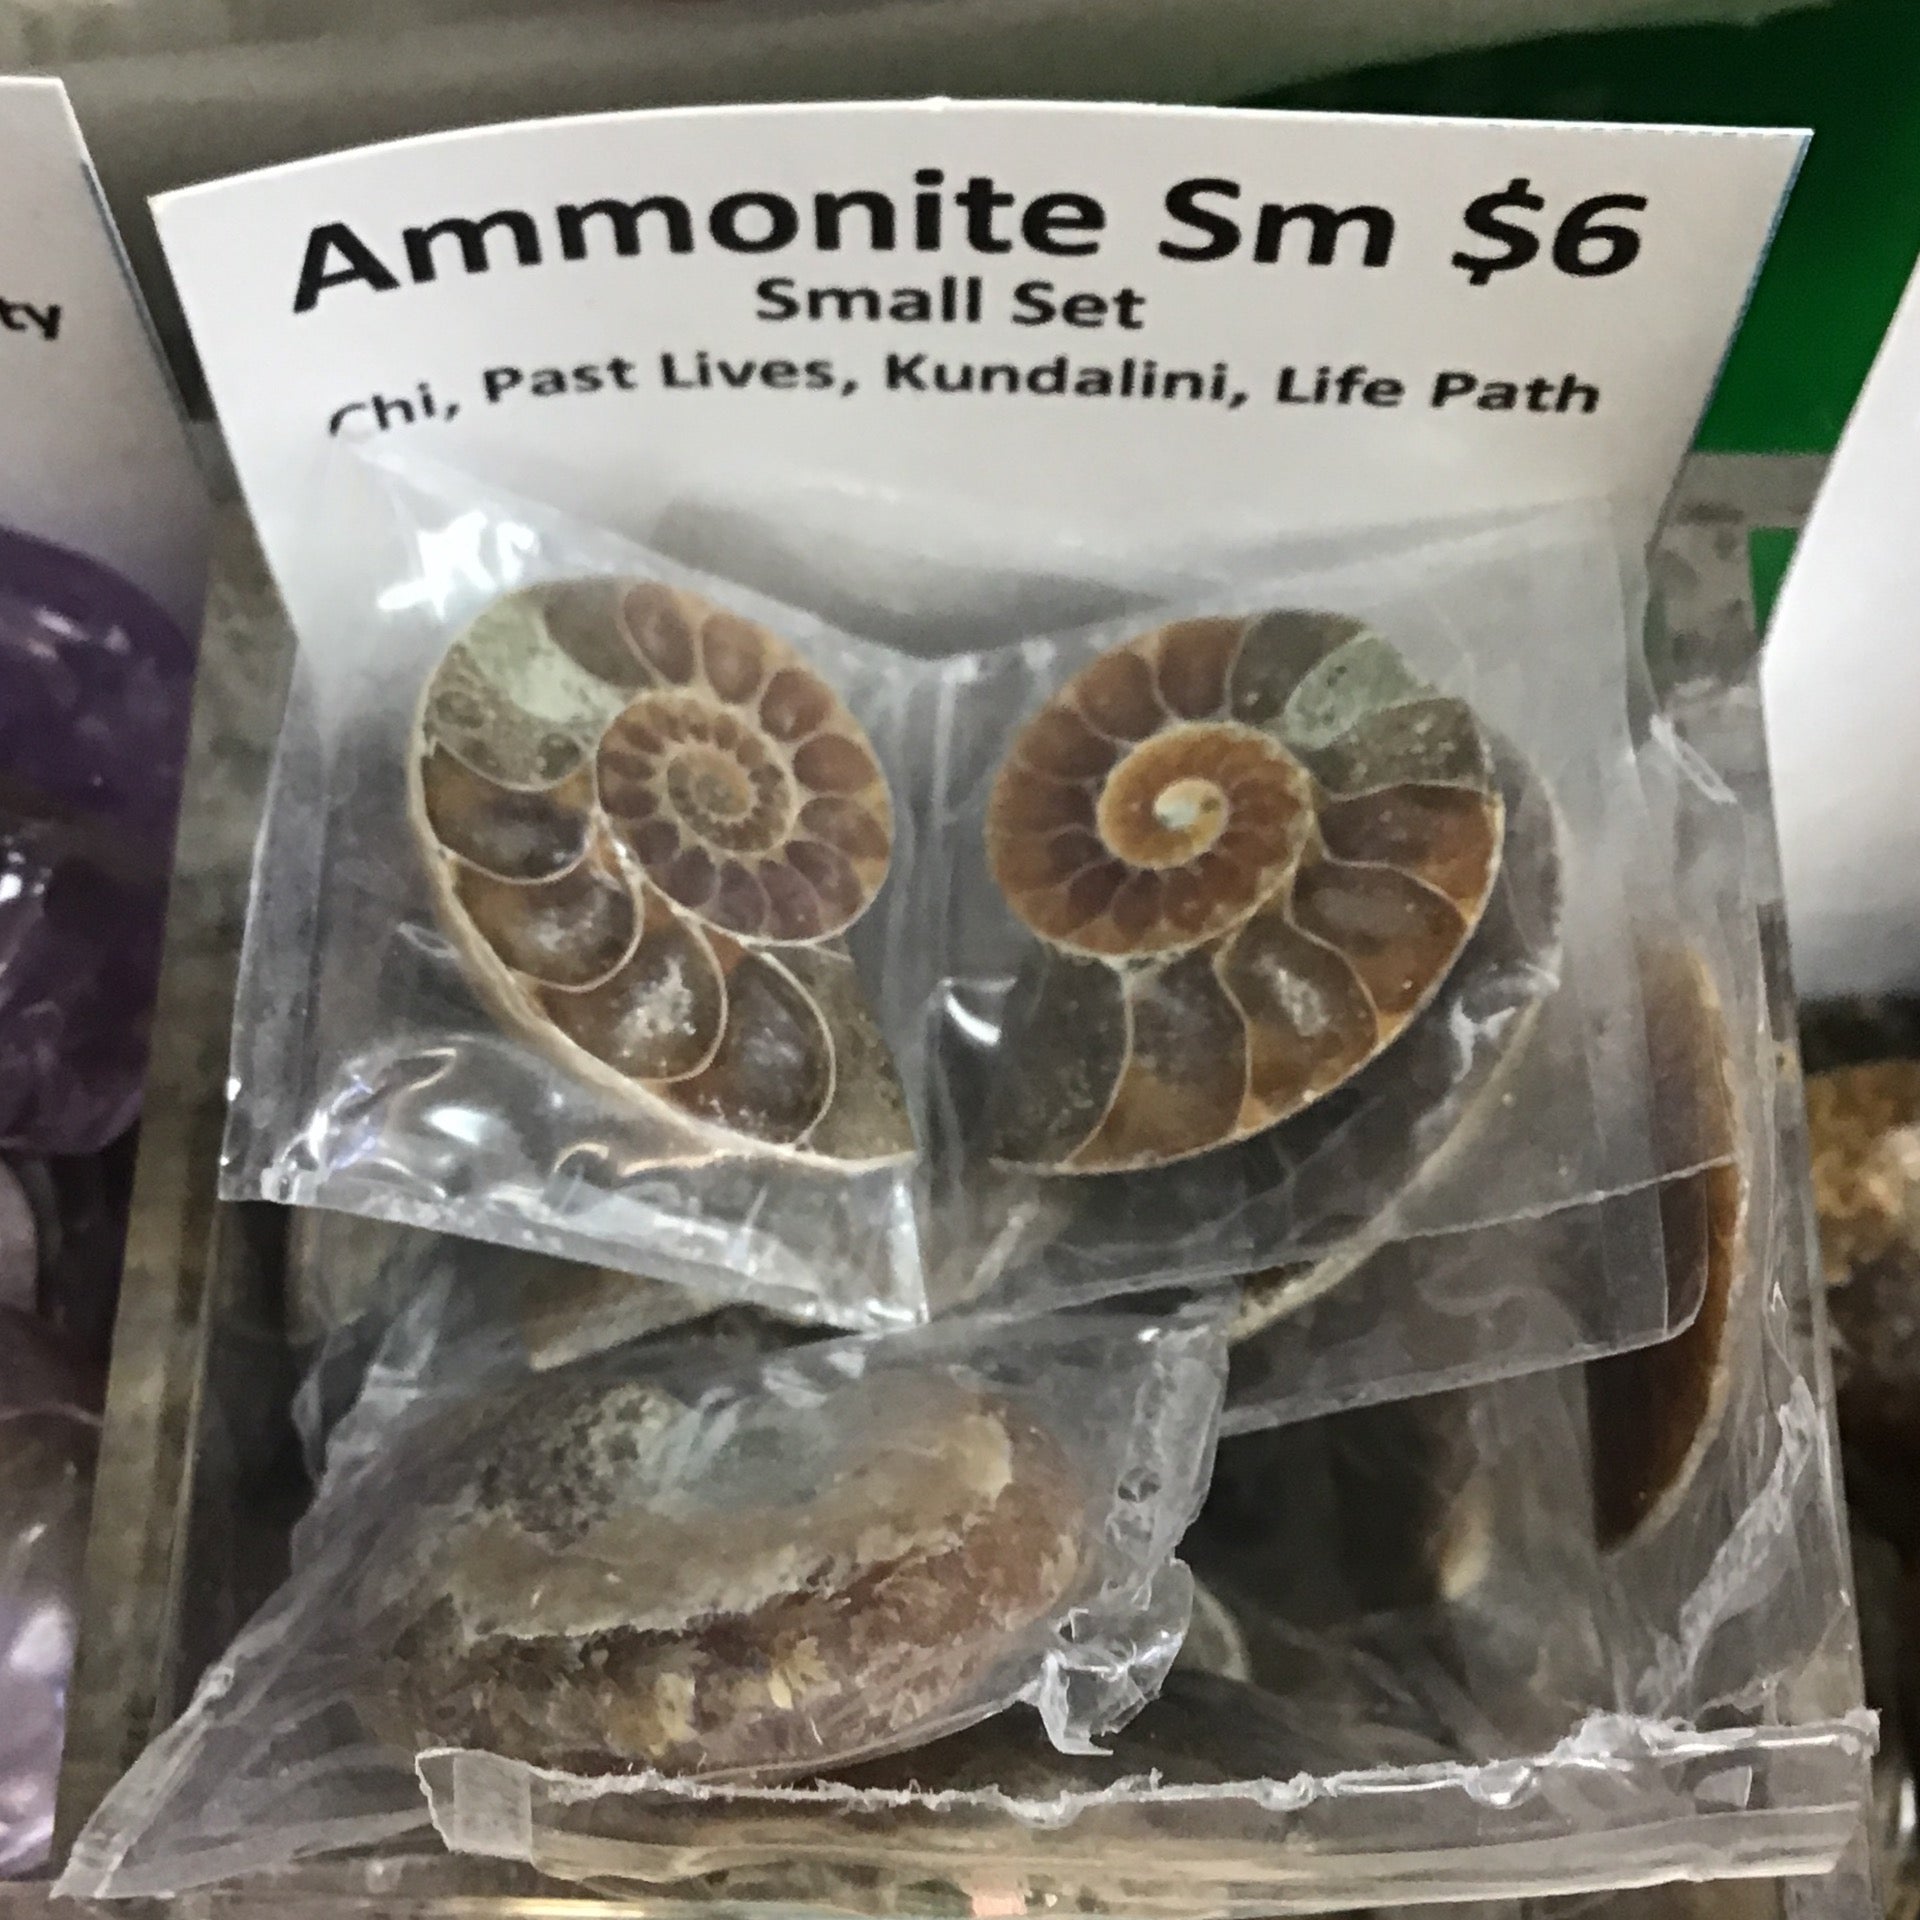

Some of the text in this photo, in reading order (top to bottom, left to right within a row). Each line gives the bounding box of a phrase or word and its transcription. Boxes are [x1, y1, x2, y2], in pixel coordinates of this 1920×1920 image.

[293, 167, 1649, 313] Ammonite Sm $6
[755, 275, 1146, 331] Small Set
[482, 354, 635, 404] Past
[659, 351, 857, 398] Lives,
[884, 354, 1248, 410] Kundalini,
[1274, 365, 1406, 408] Life
[1429, 371, 1602, 416] Path
